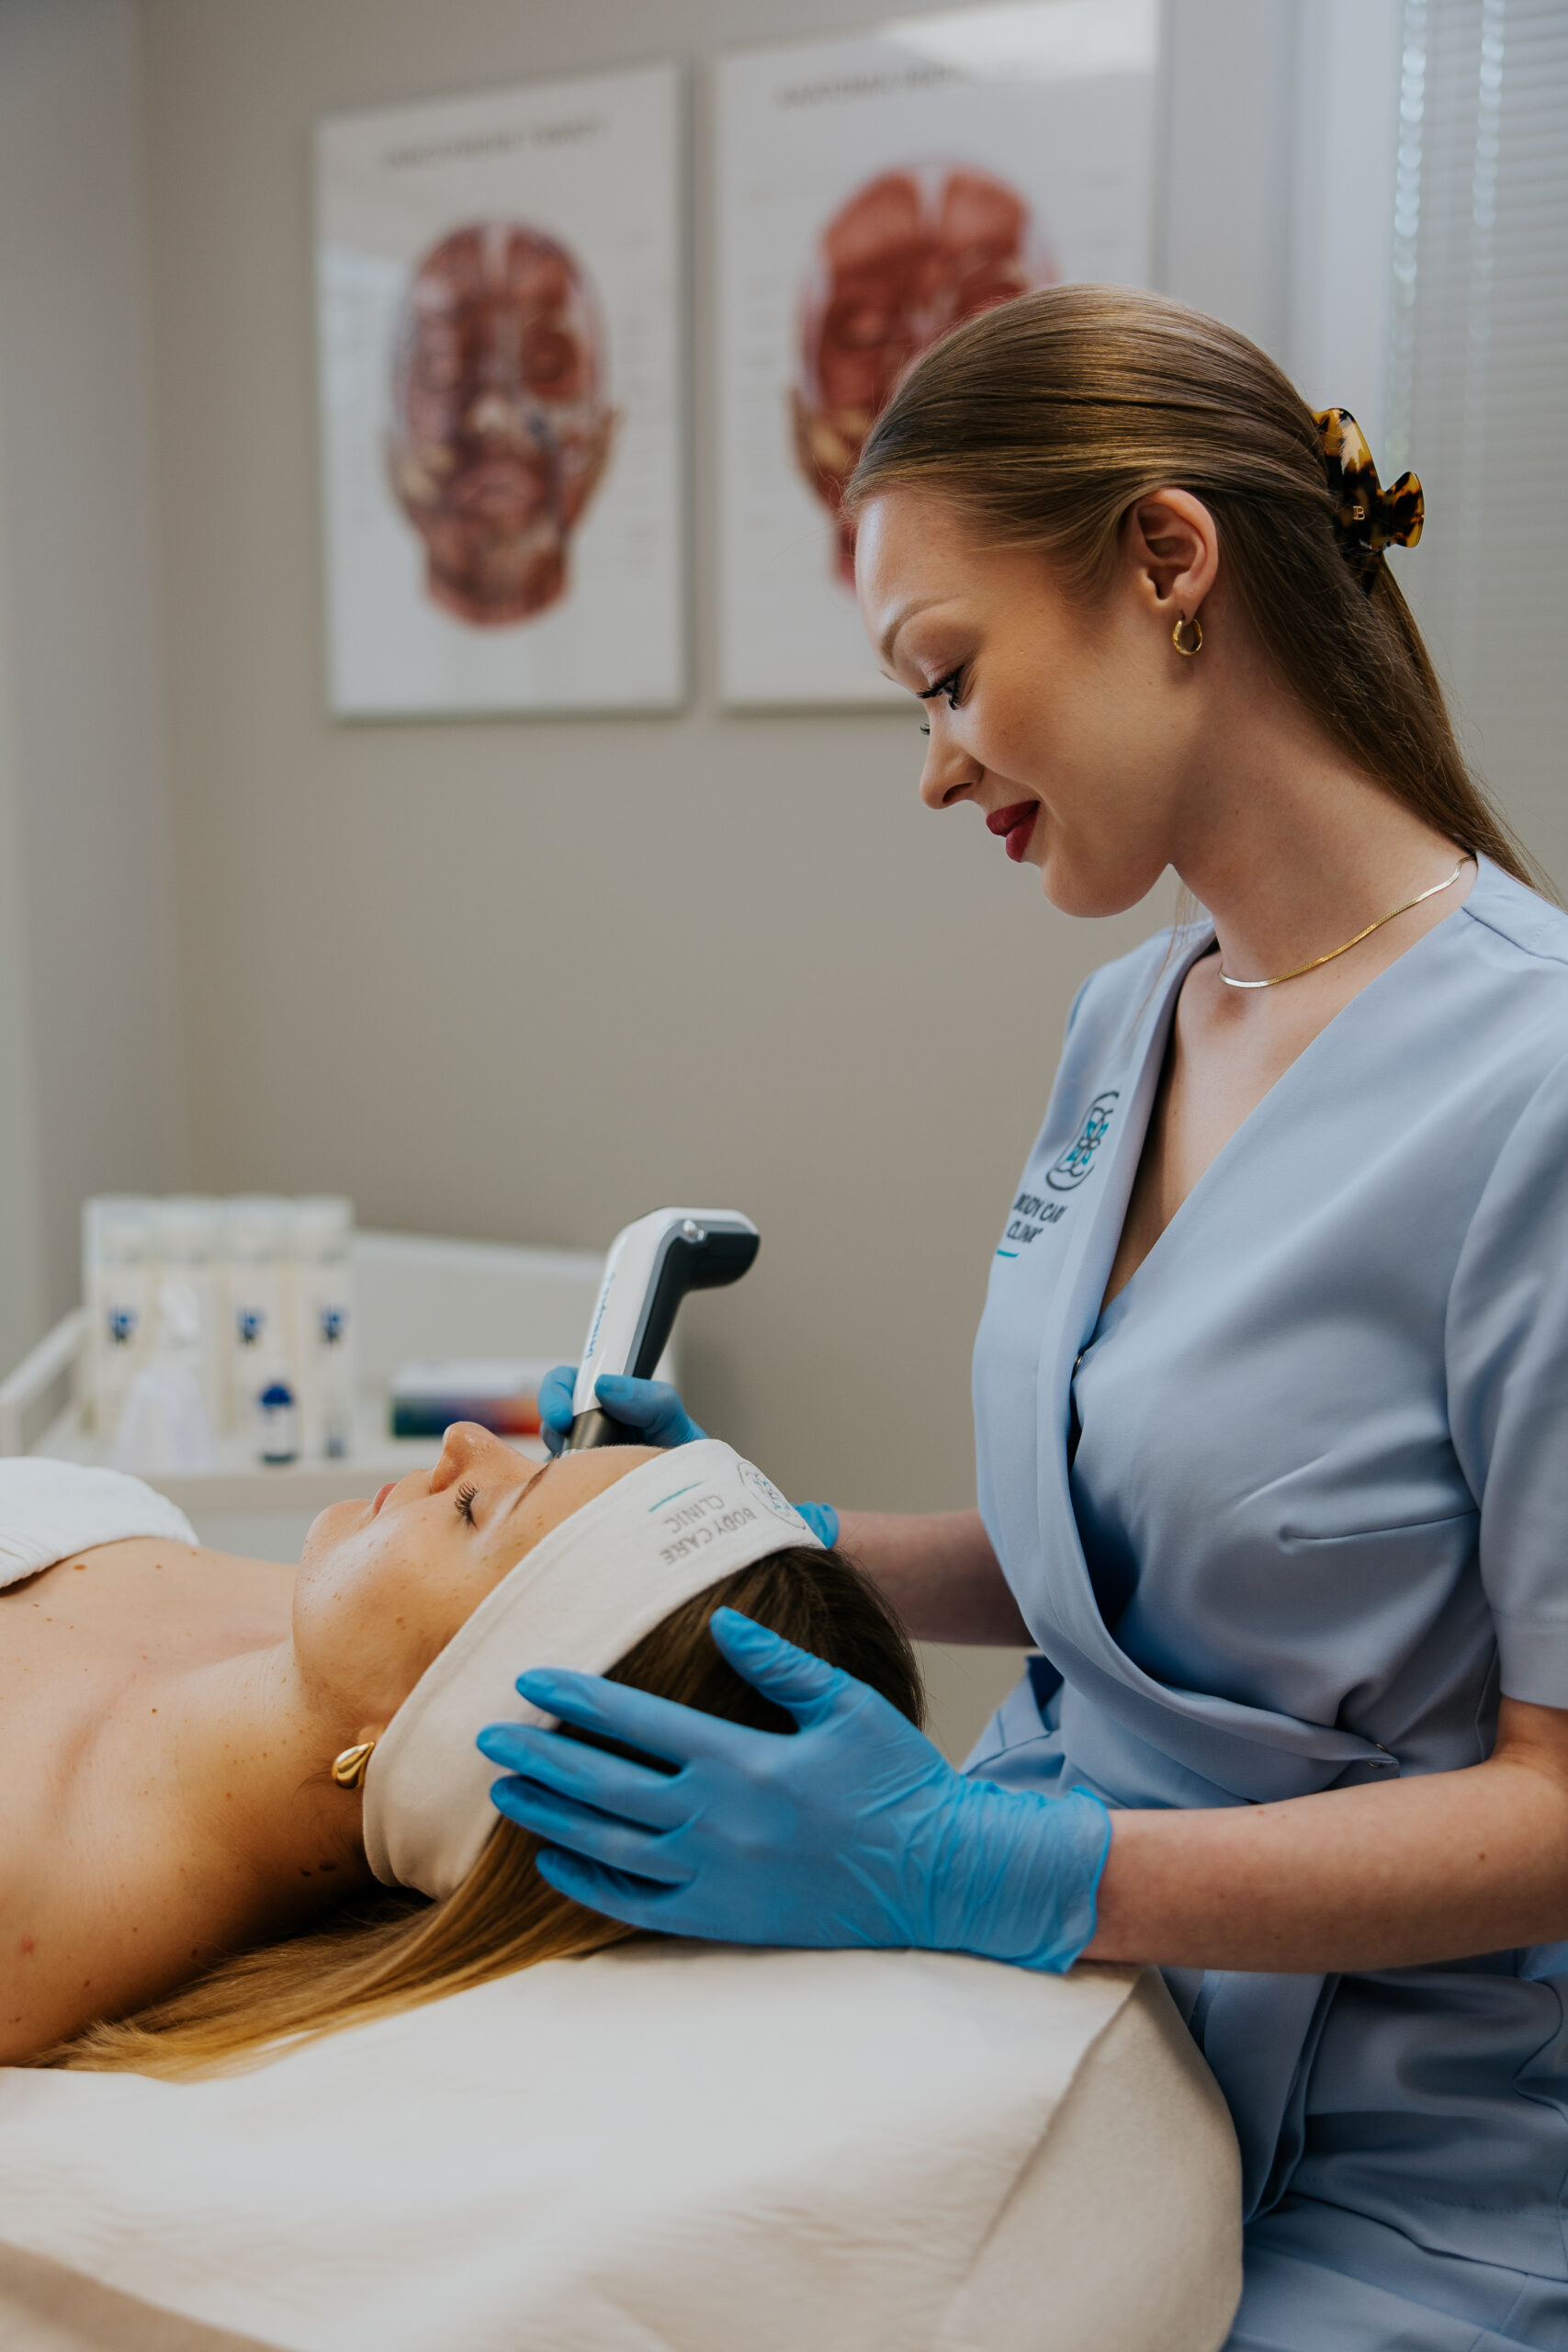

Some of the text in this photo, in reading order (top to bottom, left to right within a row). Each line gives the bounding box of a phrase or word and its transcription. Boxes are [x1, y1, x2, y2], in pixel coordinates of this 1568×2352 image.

[660, 1507, 757, 1565] BODY CARE
[664, 1495, 725, 1533] CLINIC
